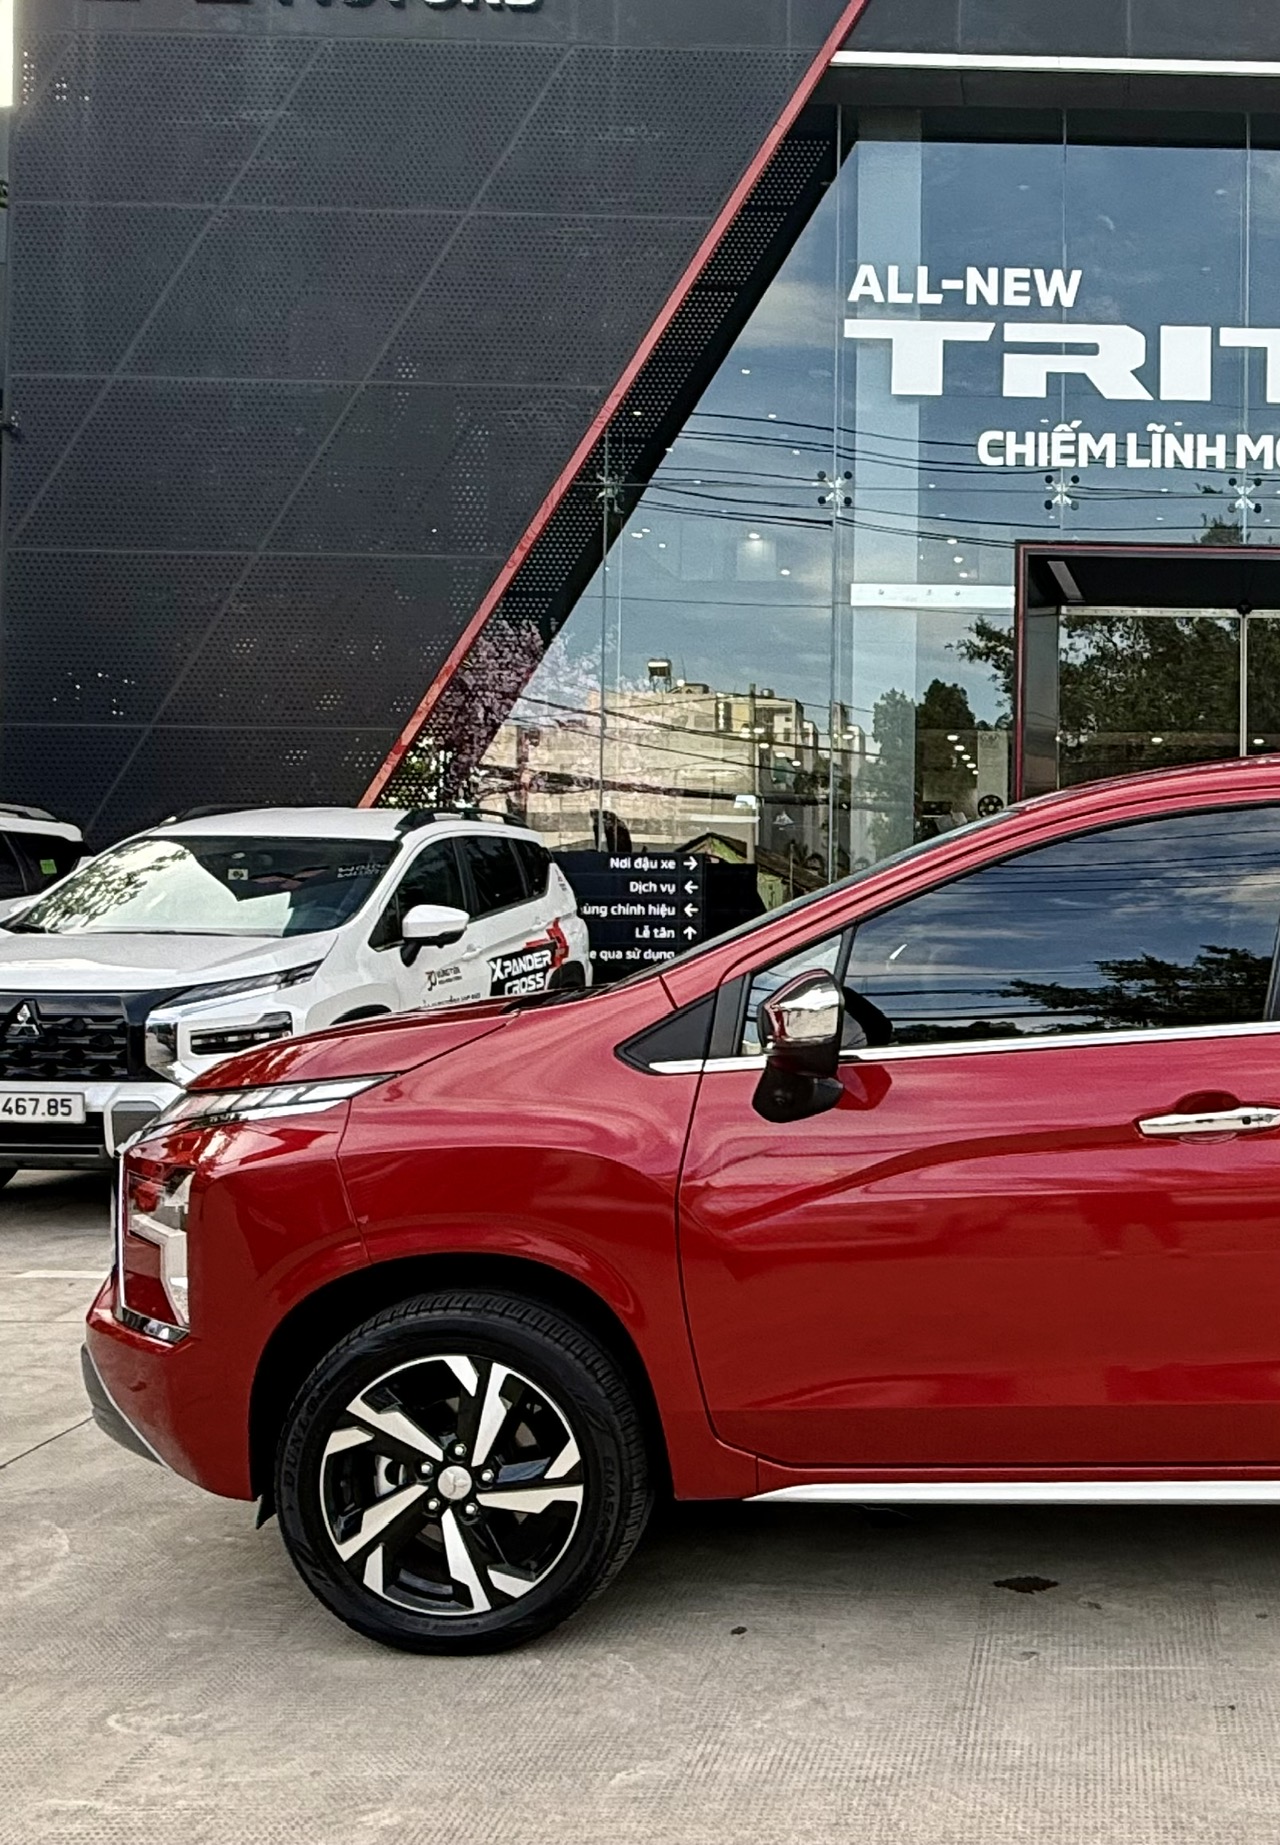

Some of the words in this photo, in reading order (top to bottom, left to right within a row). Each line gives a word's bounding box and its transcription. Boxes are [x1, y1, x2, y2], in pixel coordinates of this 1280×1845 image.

[847, 264, 1082, 308] ALL-NEW
[977, 420, 1116, 469] CHIẾM
[1126, 422, 1226, 469] LĨNH
[609, 857, 631, 869] Nơi
[634, 857, 658, 871] đậu
[660, 860, 676, 869] xe
[629, 881, 657, 894] Dịch
[660, 883, 676, 895] vụ
[580, 903, 608, 917] ùng
[610, 903, 645, 916] chính
[648, 903, 676, 918] hiệu
[635, 925, 650, 939] Lễ
[653, 927, 675, 939] tân
[589, 950, 597, 960] e
[600, 950, 623, 961] qua
[488, 949, 552, 982] XPANDER
[504, 971, 545, 995] CROSS
[1, 1097, 73, 1116] 467.85
